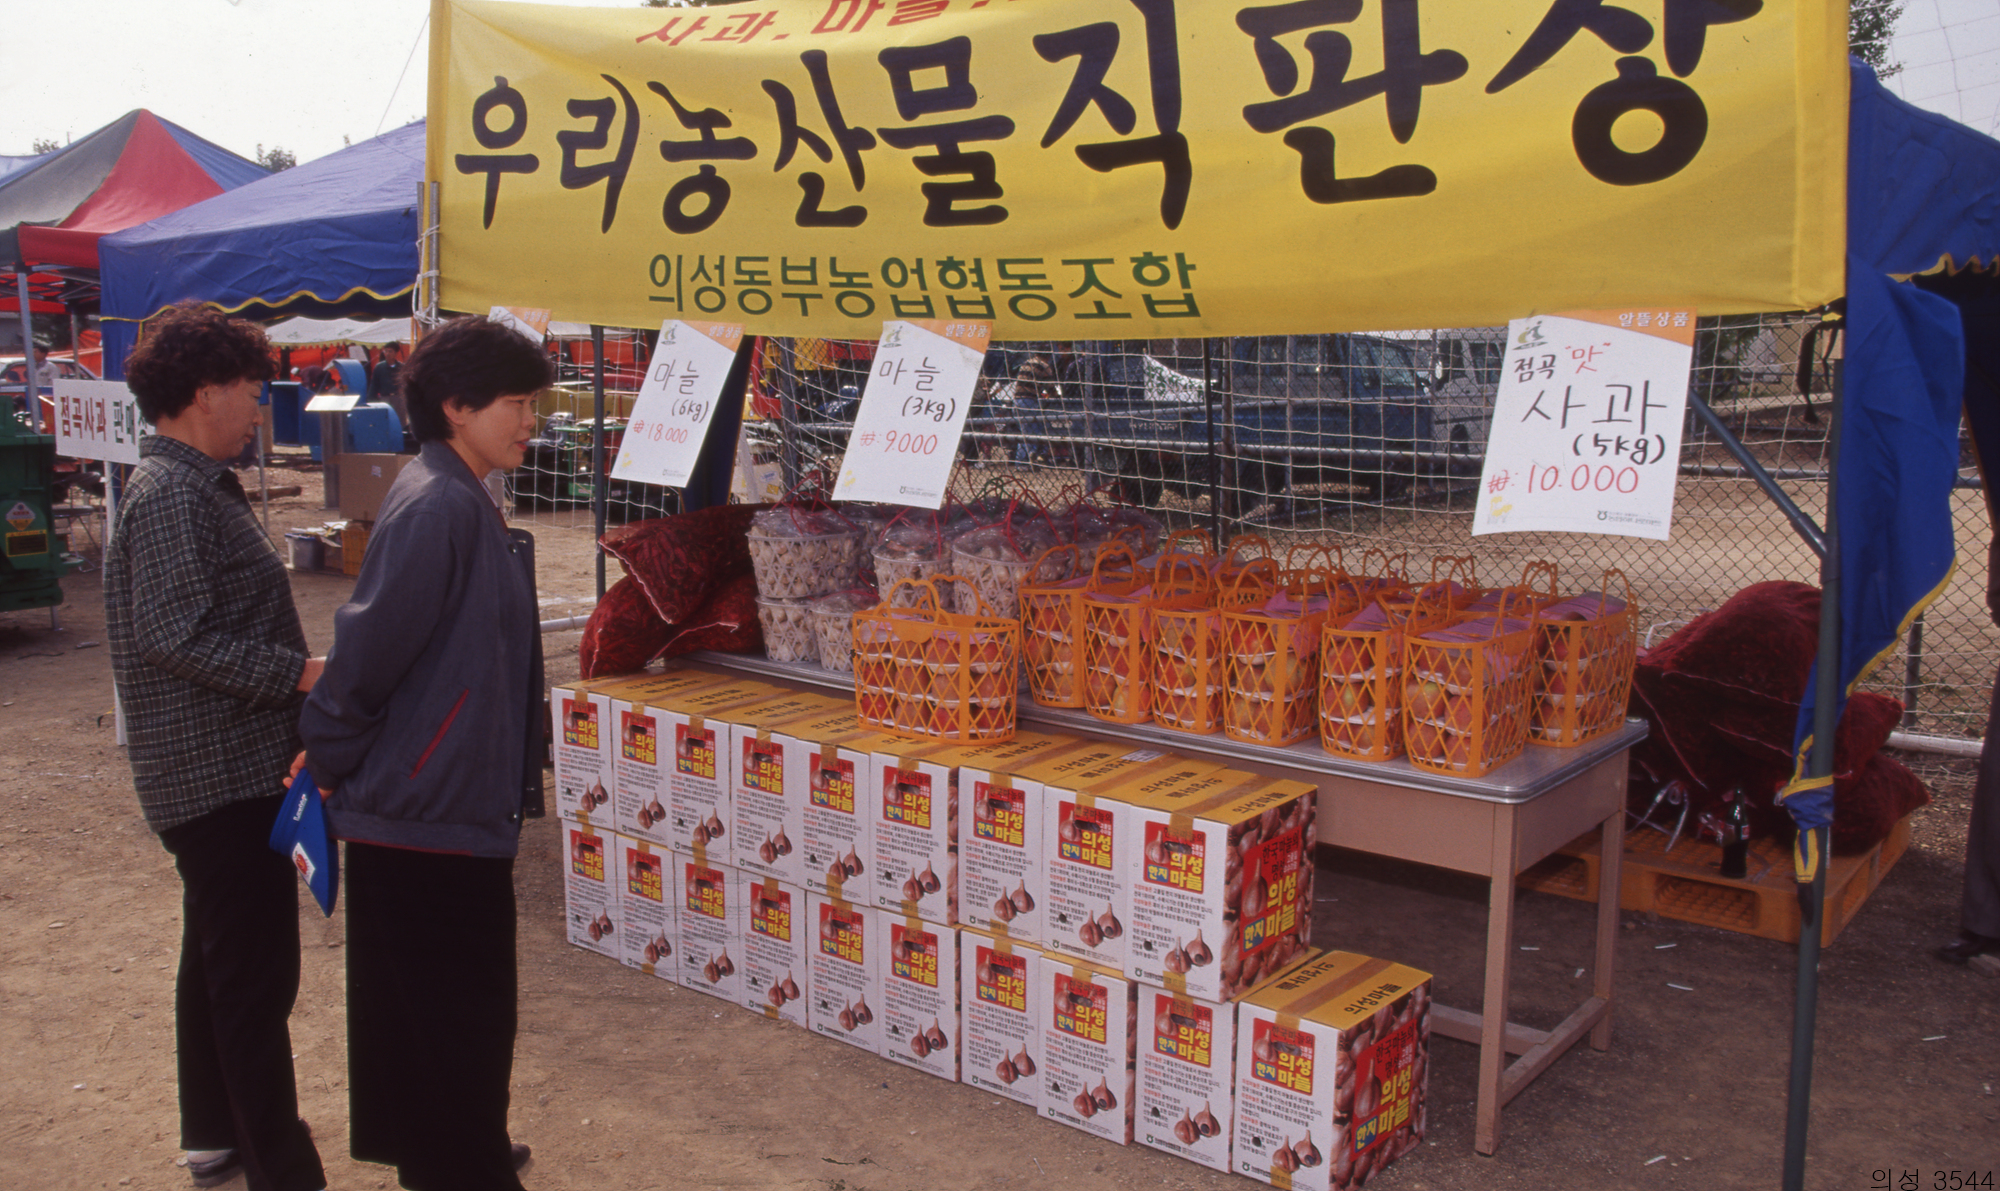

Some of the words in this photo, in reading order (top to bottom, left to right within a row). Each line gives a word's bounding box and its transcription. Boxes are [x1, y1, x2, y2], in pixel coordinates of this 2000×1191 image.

[648, 250, 1201, 321] 의성동부농업협동조합
[1618, 311, 1689, 328] 알뜰상품
[945, 324, 988, 338] 알뜰상품
[654, 359, 699, 394] 마늘
[879, 356, 941, 391] 마늘
[1513, 354, 1557, 383] 점곡
[1520, 380, 1668, 435] 사과
[60, 395, 106, 442] 점곡사과
[578, 720, 596, 735] 의성
[578, 734, 597, 747] 마늘
[636, 734, 654, 750] 의성
[636, 748, 654, 762] 마늘
[693, 748, 713, 763] 의성
[1052, 751, 1112, 773] 의성마늘
[693, 762, 714, 777] 마늘
[759, 762, 781, 779] 의성
[746, 773, 758, 784] 한지
[760, 777, 781, 792] 마늘
[829, 779, 852, 797] 의성
[1139, 770, 1198, 794] 의성마늘
[813, 791, 826, 802] 한지
[829, 794, 852, 811] 마늘
[903, 793, 928, 811] 의성
[1231, 791, 1289, 814] 의성마늘
[886, 805, 901, 817] 한지
[904, 809, 929, 826] 마늘
[995, 810, 1022, 829] 의성
[977, 822, 992, 834] 한지
[995, 826, 1022, 844] 마늘
[1081, 831, 1110, 851] 의성
[1062, 843, 1079, 856] 한지
[1082, 848, 1110, 867] 마늘
[1170, 852, 1202, 873] 의성
[1148, 865, 1166, 879] 한지
[1170, 870, 1201, 890] 마늘
[702, 887, 722, 904] 의성
[1267, 872, 1297, 909] 의성
[702, 901, 723, 917] 마늘
[767, 908, 788, 926] 의성
[754, 918, 765, 929] 한지
[768, 923, 789, 939] 마늘
[1244, 919, 1264, 950] 한지
[1266, 903, 1295, 938] 마늘
[838, 930, 861, 948] 의성
[823, 939, 836, 951] 한지
[838, 944, 861, 962] 마늘
[911, 952, 935, 970] 의성
[895, 962, 908, 974] 한지
[911, 967, 935, 984] 마늘
[997, 975, 1023, 994] 의성
[980, 985, 995, 997] 한지
[998, 990, 1024, 1009] 마늘
[1343, 982, 1403, 1015] 의성마늘
[1076, 1005, 1104, 1025] 의성
[1057, 1014, 1073, 1028] 한지
[1076, 1021, 1104, 1041] 마늘
[1179, 1026, 1209, 1048] 의성
[1158, 1037, 1175, 1051] 한지
[1178, 1043, 1208, 1064] 마늘
[1278, 1052, 1311, 1075] 의성
[1256, 1062, 1274, 1077] 한지
[1278, 1069, 1310, 1092] 마늘
[1380, 1065, 1412, 1106] 의성
[1357, 1117, 1377, 1150] 한지
[1378, 1096, 1411, 1135] 마늘
